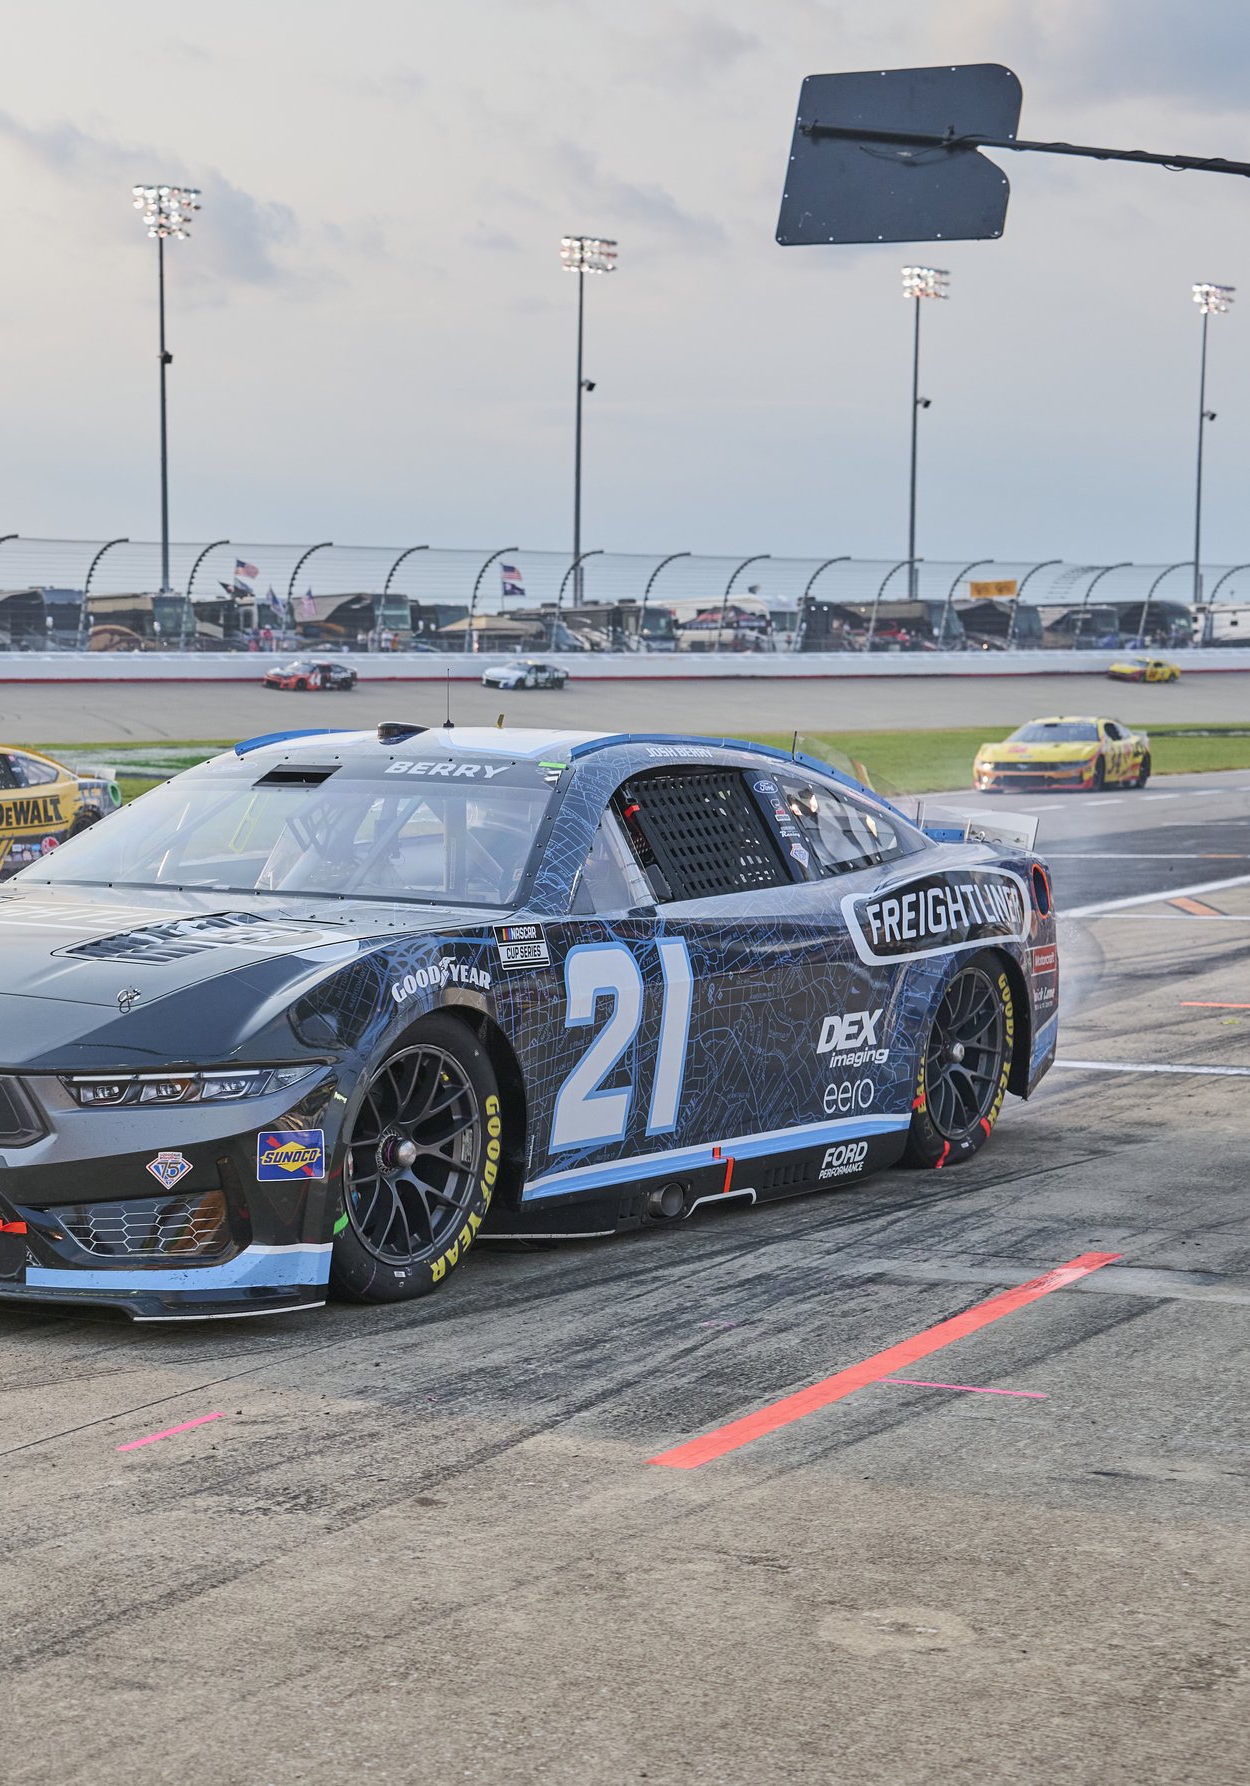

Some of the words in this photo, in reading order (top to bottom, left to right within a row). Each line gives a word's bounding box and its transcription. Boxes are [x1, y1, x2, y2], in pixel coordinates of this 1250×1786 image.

[646, 747, 675, 758] JOSH
[676, 747, 713, 758] BERRY
[384, 761, 511, 779] BERRY
[867, 884, 1022, 945] FREIGHTLINER
[510, 926, 537, 940] NASCAR
[506, 947, 522, 959] CUP
[521, 945, 541, 958] SERIES
[816, 1008, 884, 1054] DEX
[549, 937, 693, 1154] 21
[829, 1048, 889, 1068] imaging
[823, 1078, 874, 1113] eero
[263, 1149, 318, 1164] SUNOCO
[821, 1141, 868, 1169] FORD
[157, 1161, 182, 1179] 75
[818, 1161, 864, 1180] PERFORMANCE
